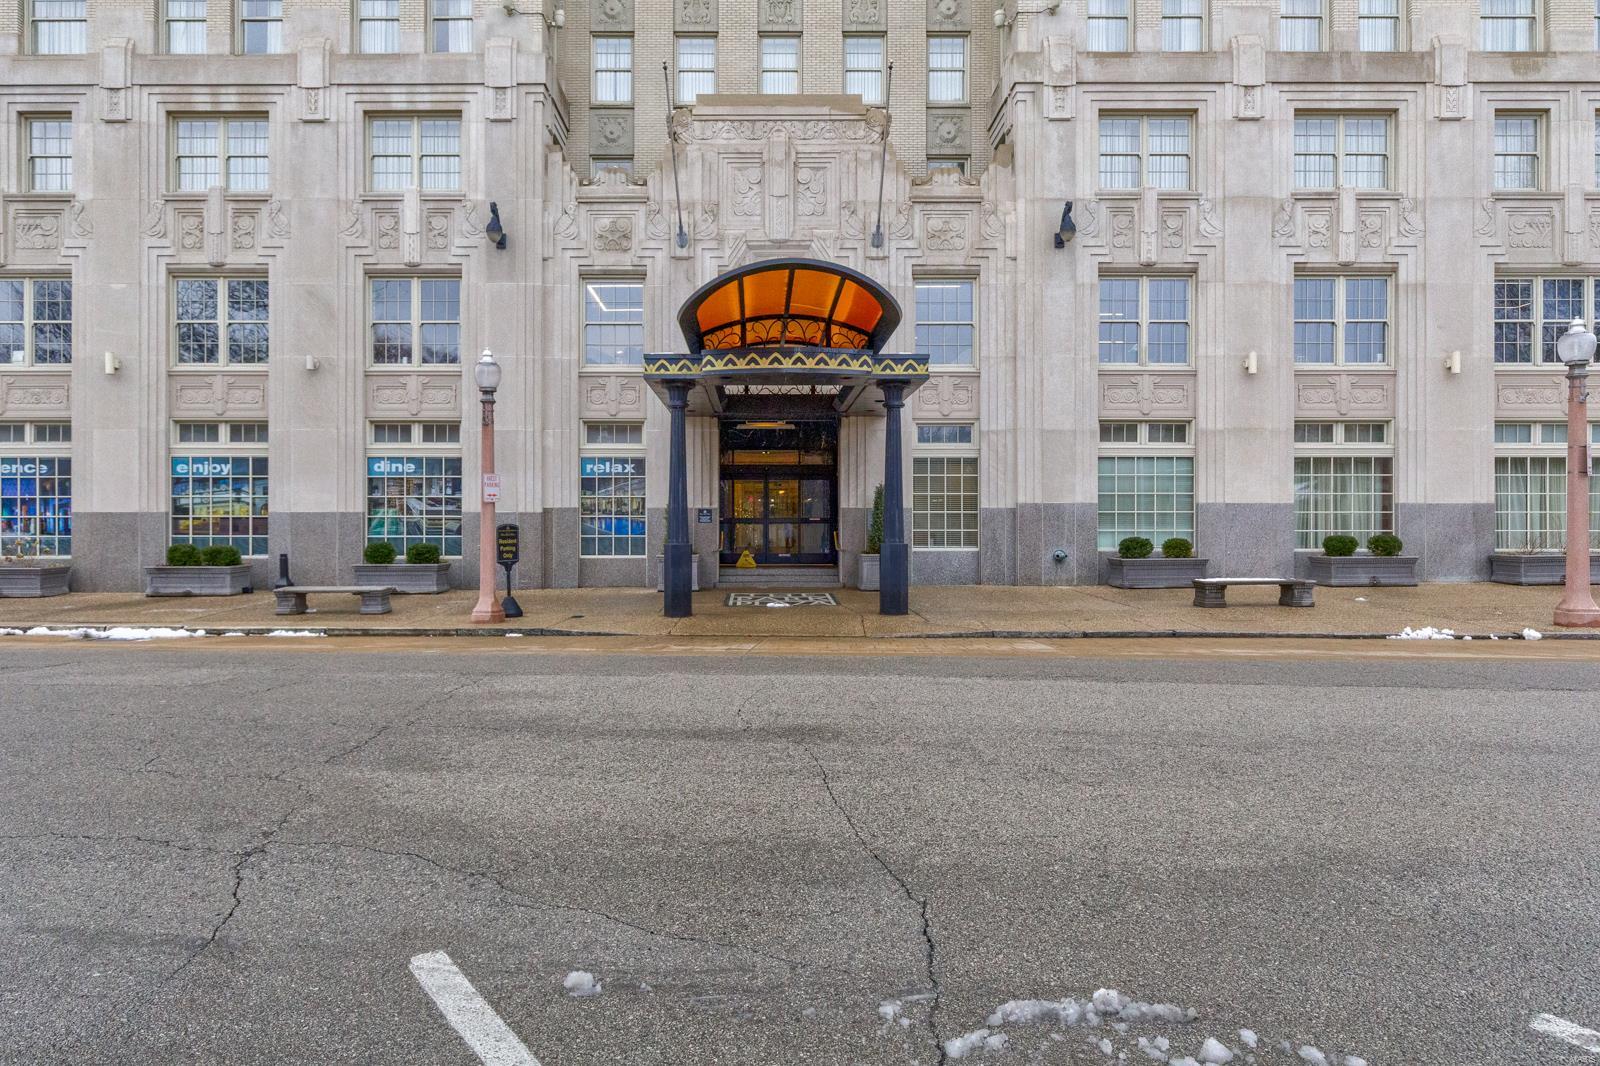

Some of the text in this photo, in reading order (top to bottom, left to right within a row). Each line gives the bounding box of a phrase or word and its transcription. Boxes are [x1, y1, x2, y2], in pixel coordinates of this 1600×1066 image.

[1, 463, 48, 474] ence
[176, 461, 231, 475] enjoy
[373, 461, 416, 472] dine
[585, 461, 636, 473] relax
